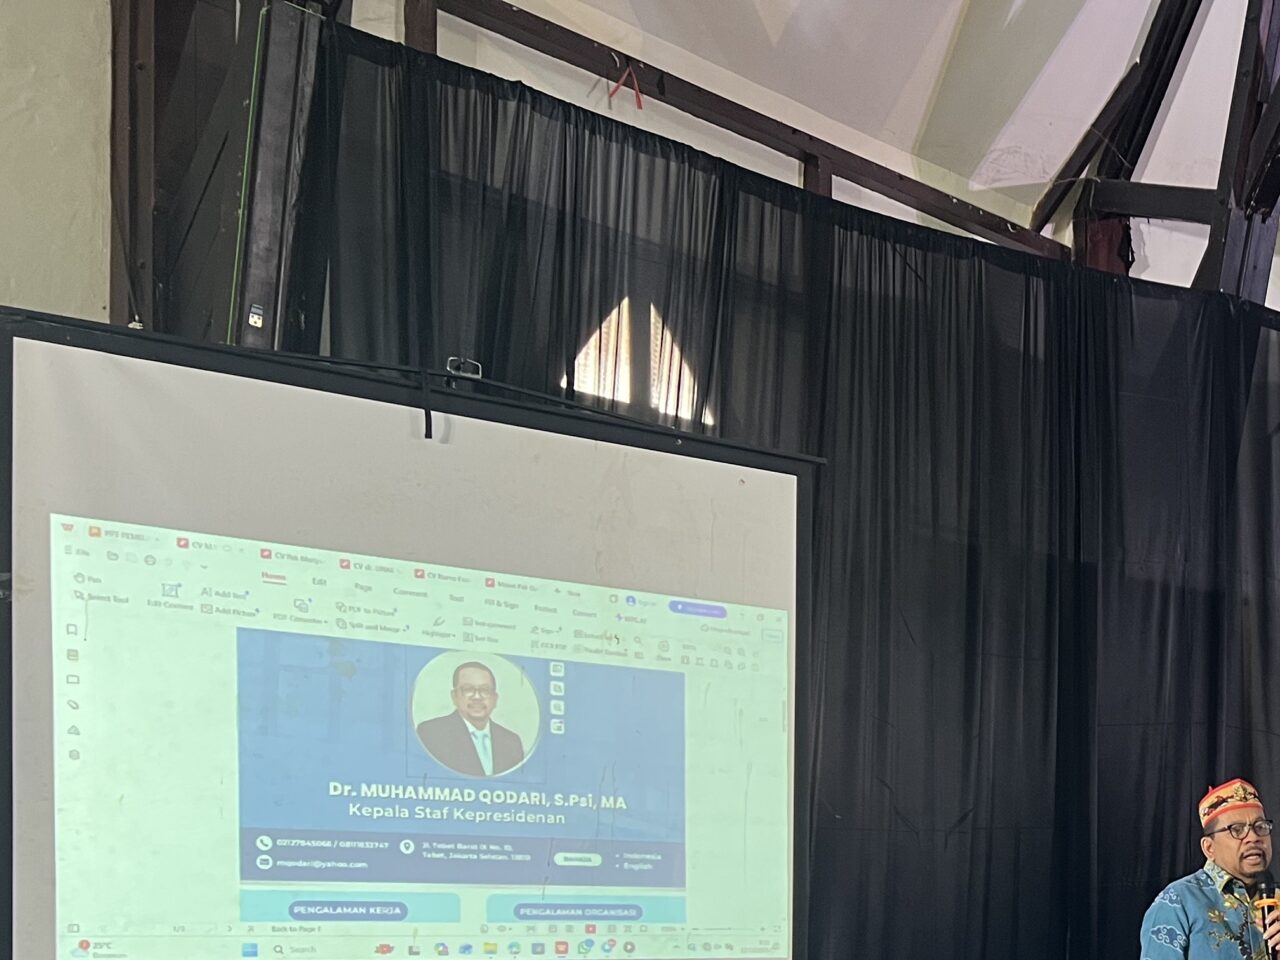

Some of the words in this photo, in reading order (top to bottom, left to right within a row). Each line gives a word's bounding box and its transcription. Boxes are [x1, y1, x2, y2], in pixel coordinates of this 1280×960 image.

[328, 781, 357, 796] Dr.
[361, 783, 475, 802] MUHAMMAD
[479, 790, 550, 808] QODARI,
[553, 793, 598, 810] S.Psi,
[601, 797, 627, 809] MA
[349, 803, 409, 819] Kepala
[415, 805, 448, 820] Staf
[453, 807, 565, 824] Kepresidenan
[293, 906, 366, 915] PENGALAMAN
[369, 906, 401, 915] KERJA
[519, 908, 583, 916] PENGALAMAN
